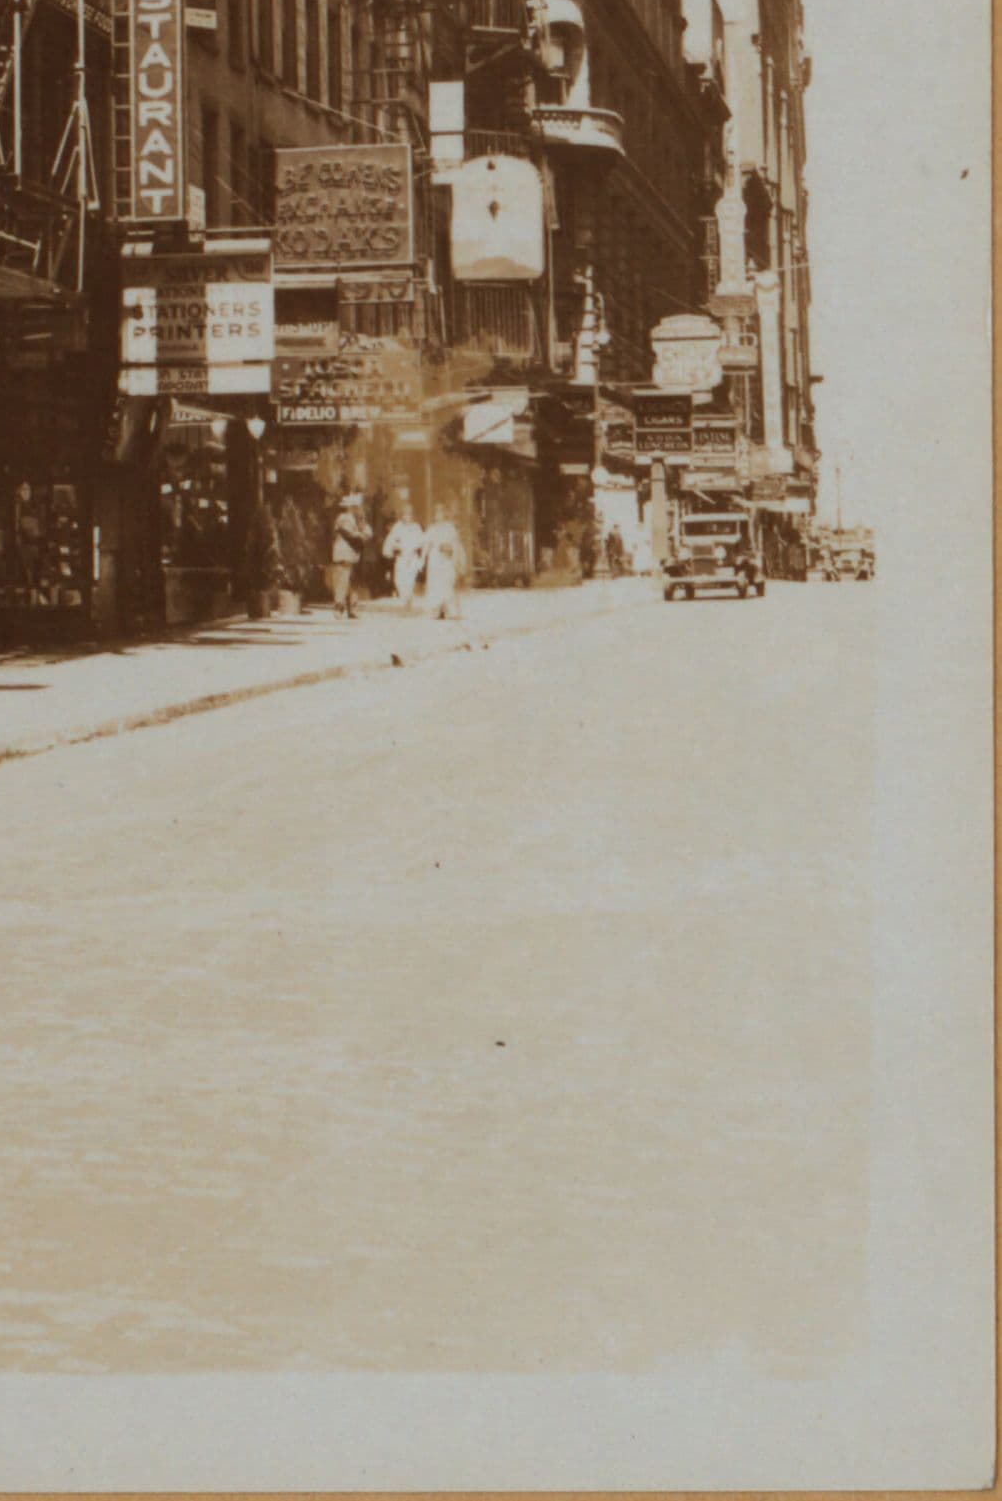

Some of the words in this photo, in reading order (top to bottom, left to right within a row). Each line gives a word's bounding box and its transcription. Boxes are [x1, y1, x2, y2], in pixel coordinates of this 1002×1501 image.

[165, 264, 231, 283] SILVER
[132, 301, 262, 320] STATIONERS
[132, 323, 261, 340] PRINTERS
[644, 415, 684, 425] CIGARS
[638, 441, 690, 450] LUNCHEON
